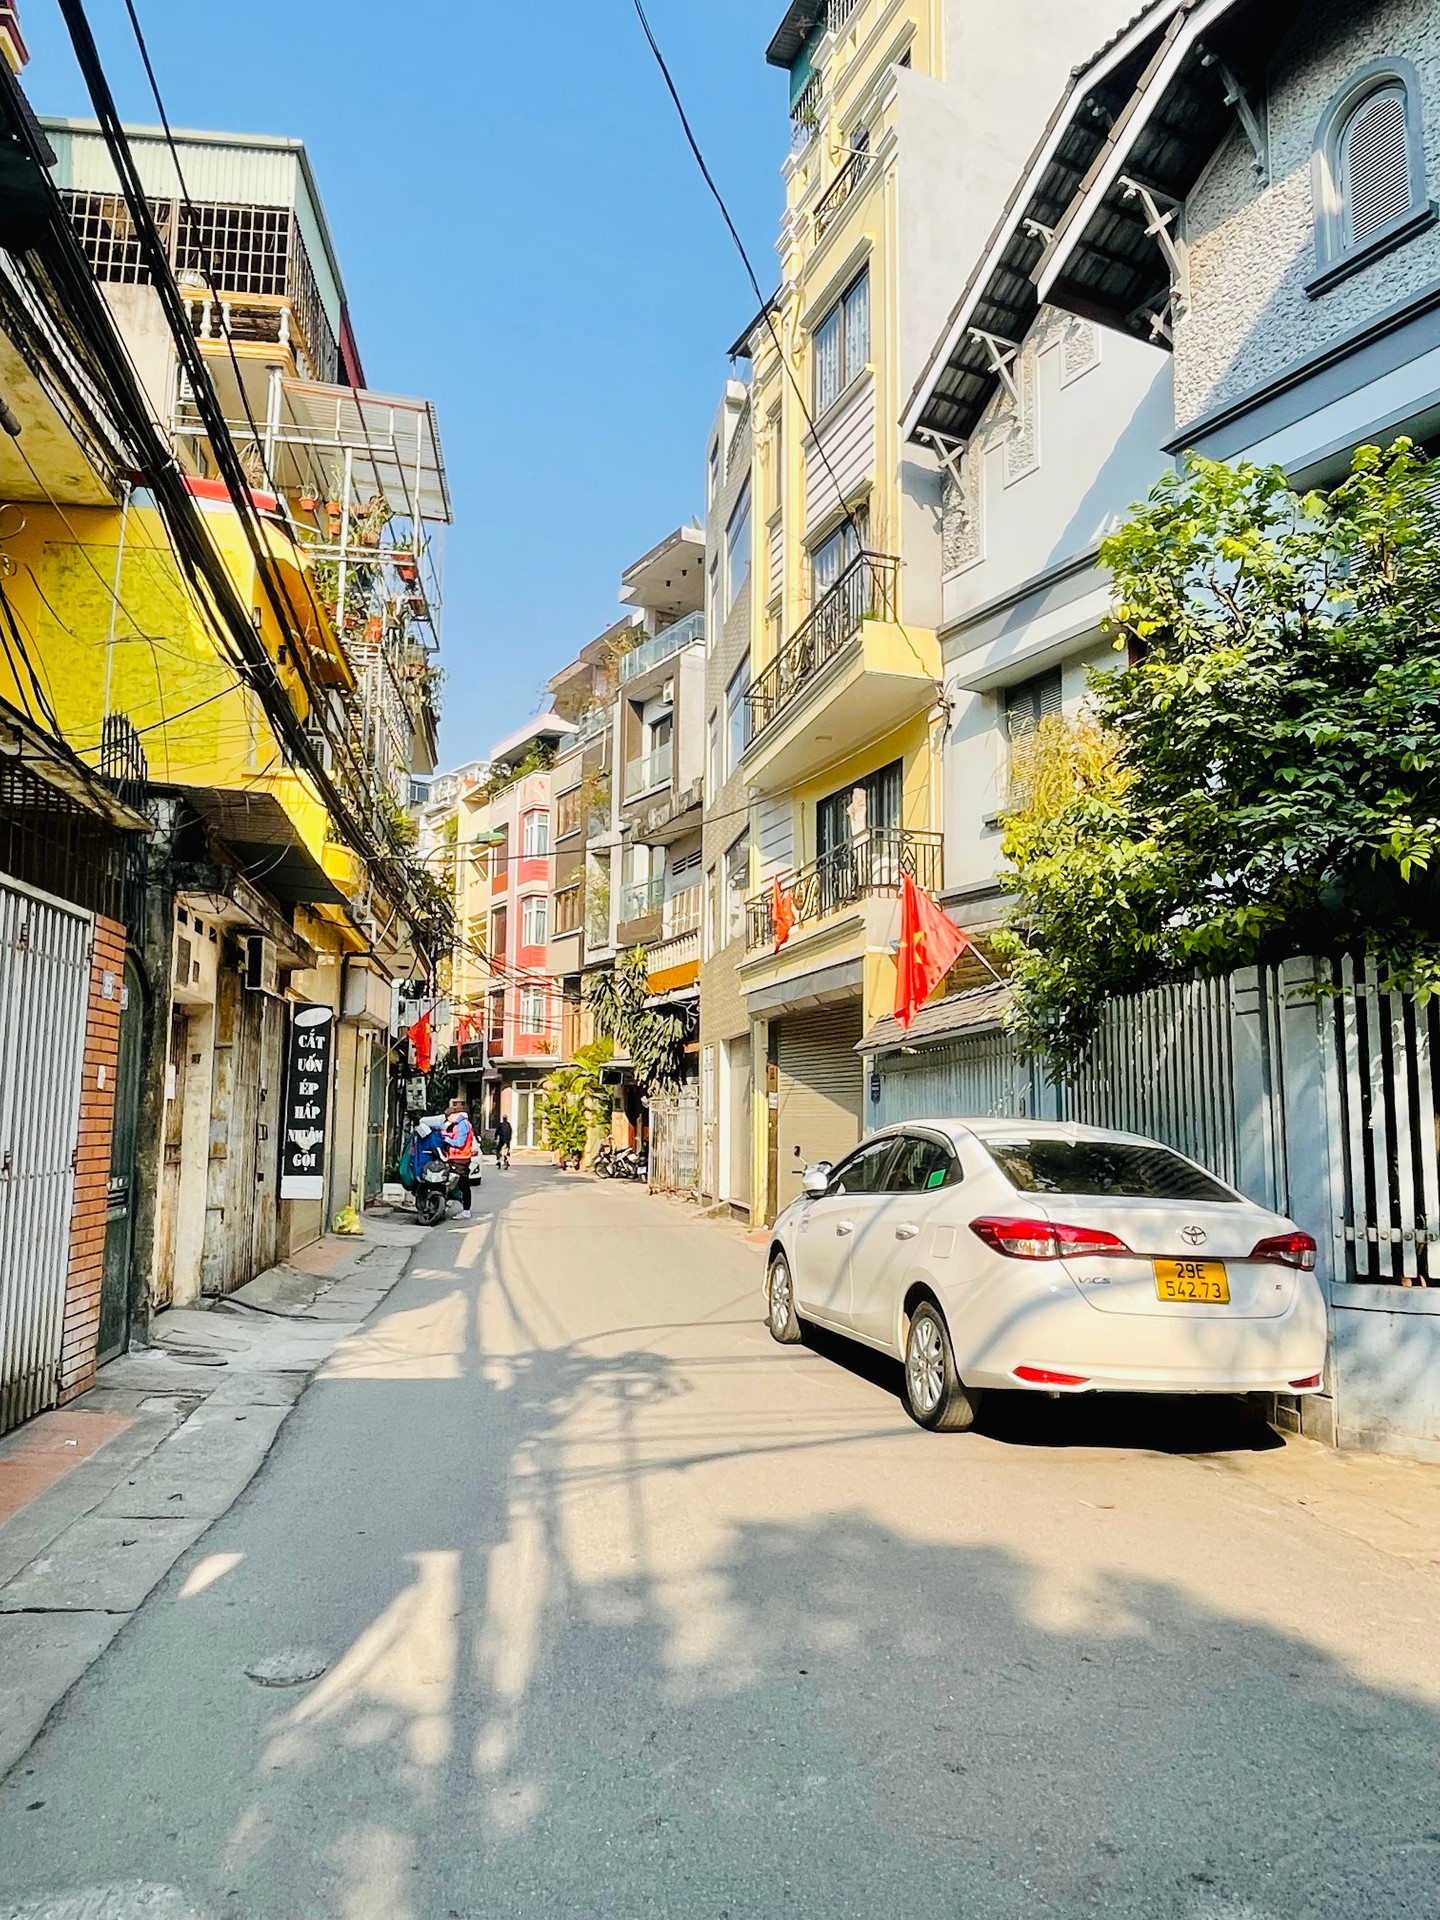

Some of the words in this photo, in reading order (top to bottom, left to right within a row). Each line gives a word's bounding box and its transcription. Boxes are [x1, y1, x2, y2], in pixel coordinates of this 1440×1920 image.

[298, 1028, 325, 1049] CẮT
[297, 1053, 323, 1072] UỐN
[298, 1078, 320, 1096] ÉP
[294, 1099, 321, 1119] HẤP
[292, 1153, 316, 1171] GỌI
[1175, 1262, 1206, 1280] 29E
[1166, 1280, 1222, 1299] 542.73
